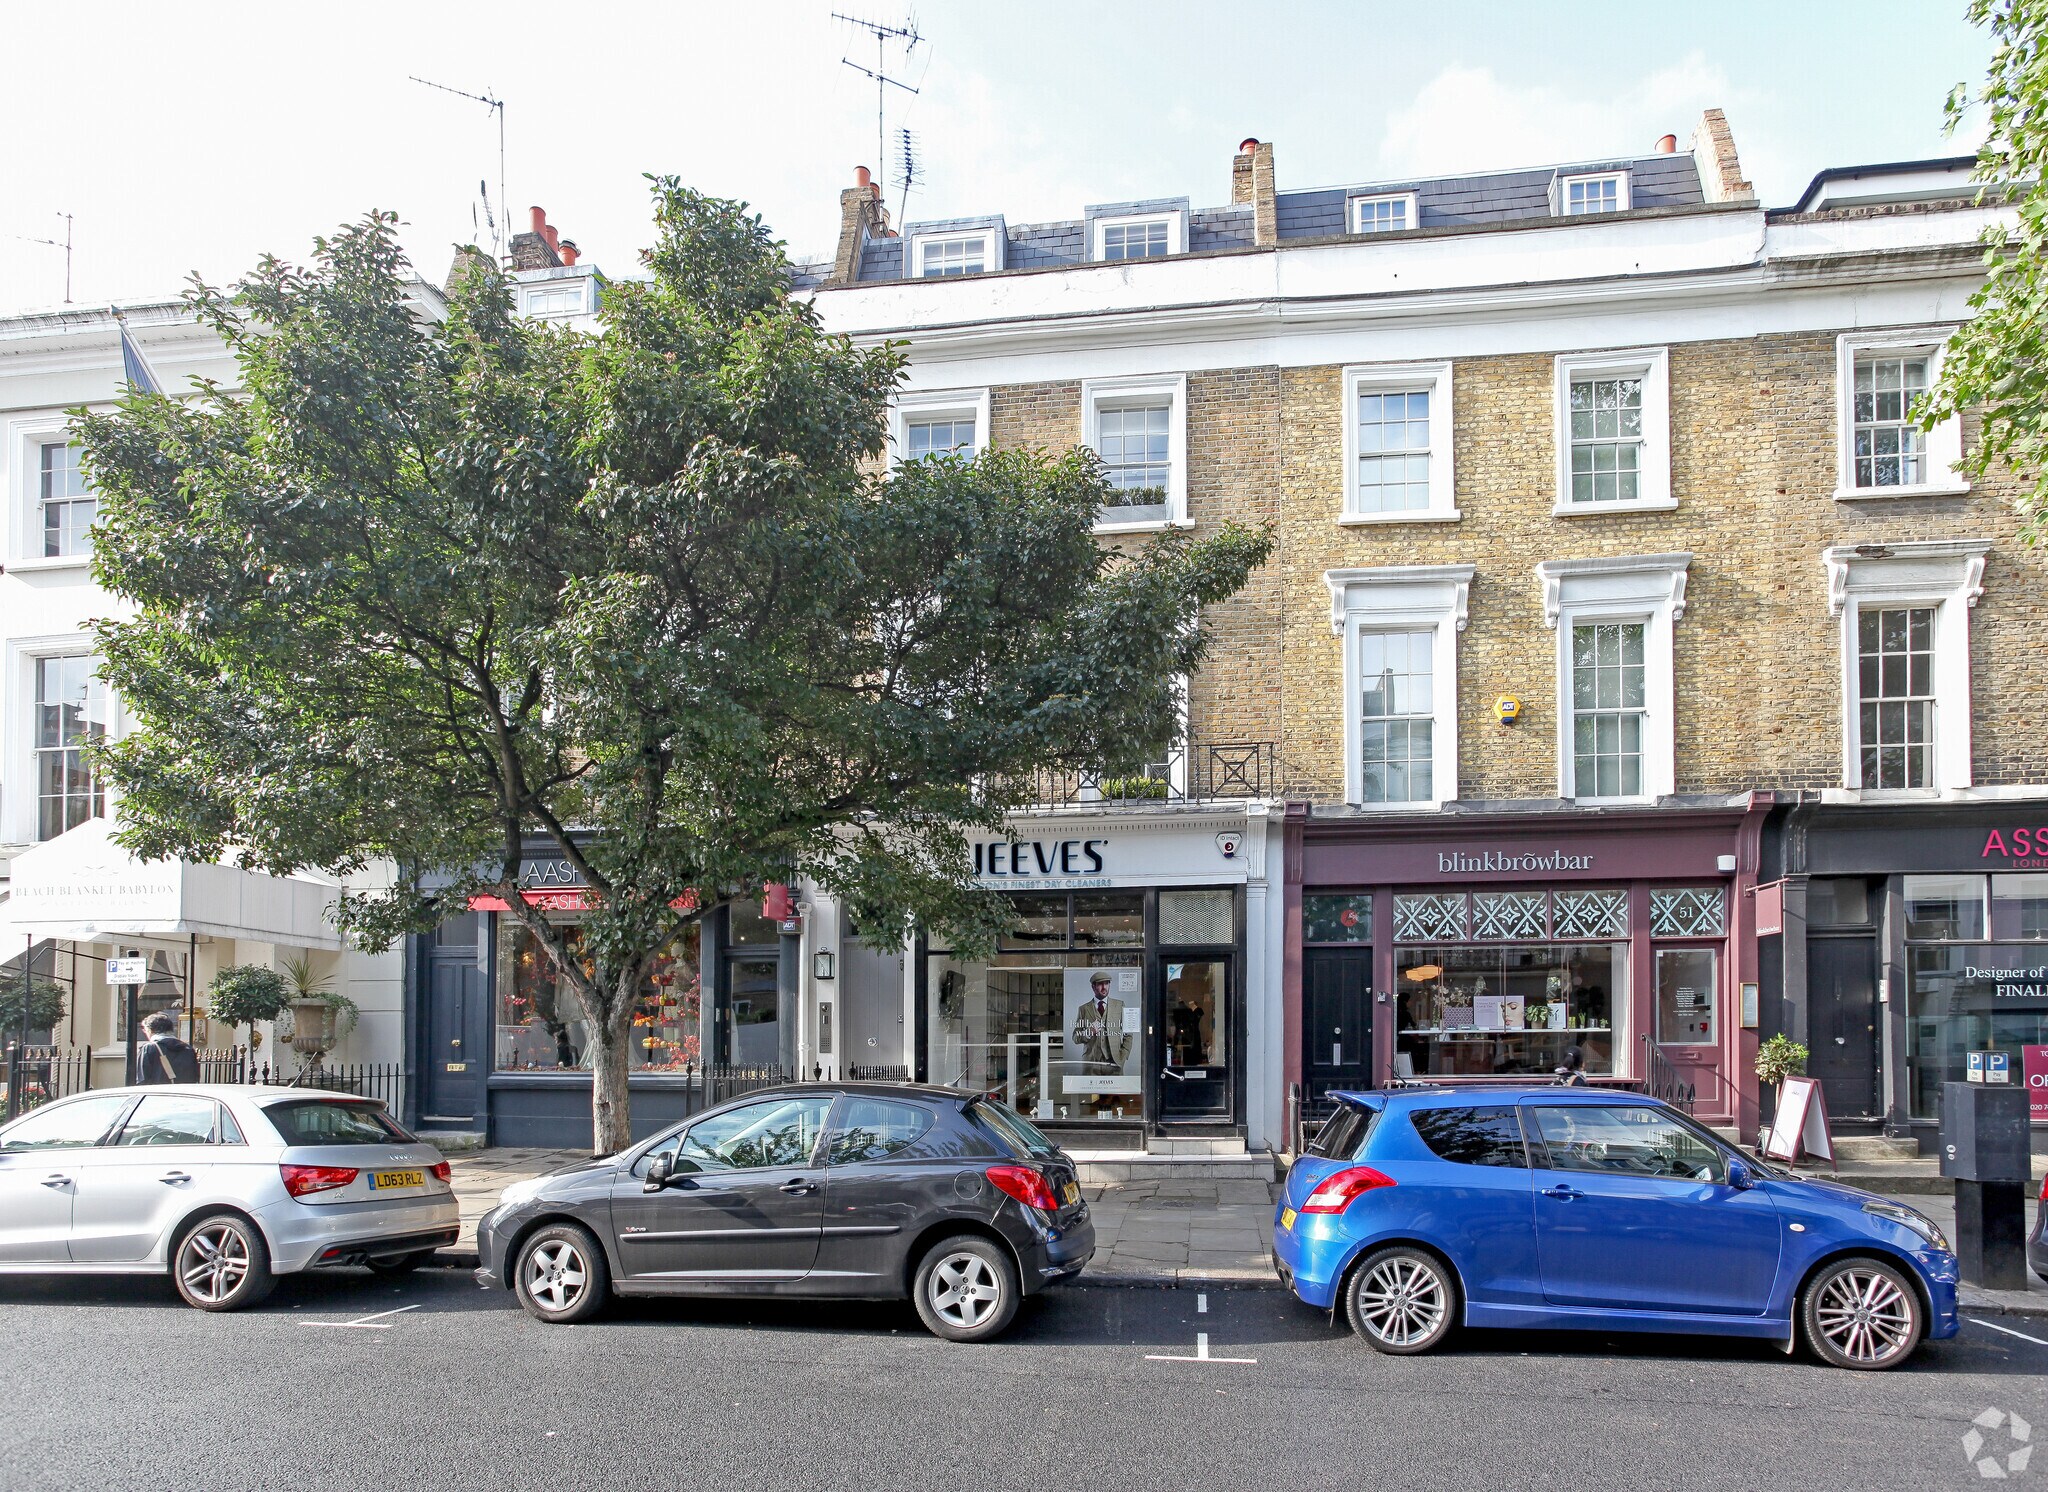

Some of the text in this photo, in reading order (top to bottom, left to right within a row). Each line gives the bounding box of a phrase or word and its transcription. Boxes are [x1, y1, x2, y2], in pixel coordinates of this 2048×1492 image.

[1502, 702, 1514, 710] ADT
[972, 840, 1103, 875] JEEVES
[15, 884, 174, 897] BEACH BLANKET BABYLON
[1010, 880, 1041, 889] FINEST
[1044, 880, 1062, 889] DRY
[1065, 878, 1112, 888] CLEANERS
[1679, 906, 1694, 919] 51
[110, 962, 117, 972] P
[1965, 965, 2047, 981] Designer of
[1970, 1054, 1980, 1069] P
[1990, 1054, 2004, 1070] P
[377, 1172, 424, 1187] LD63 RLZ
